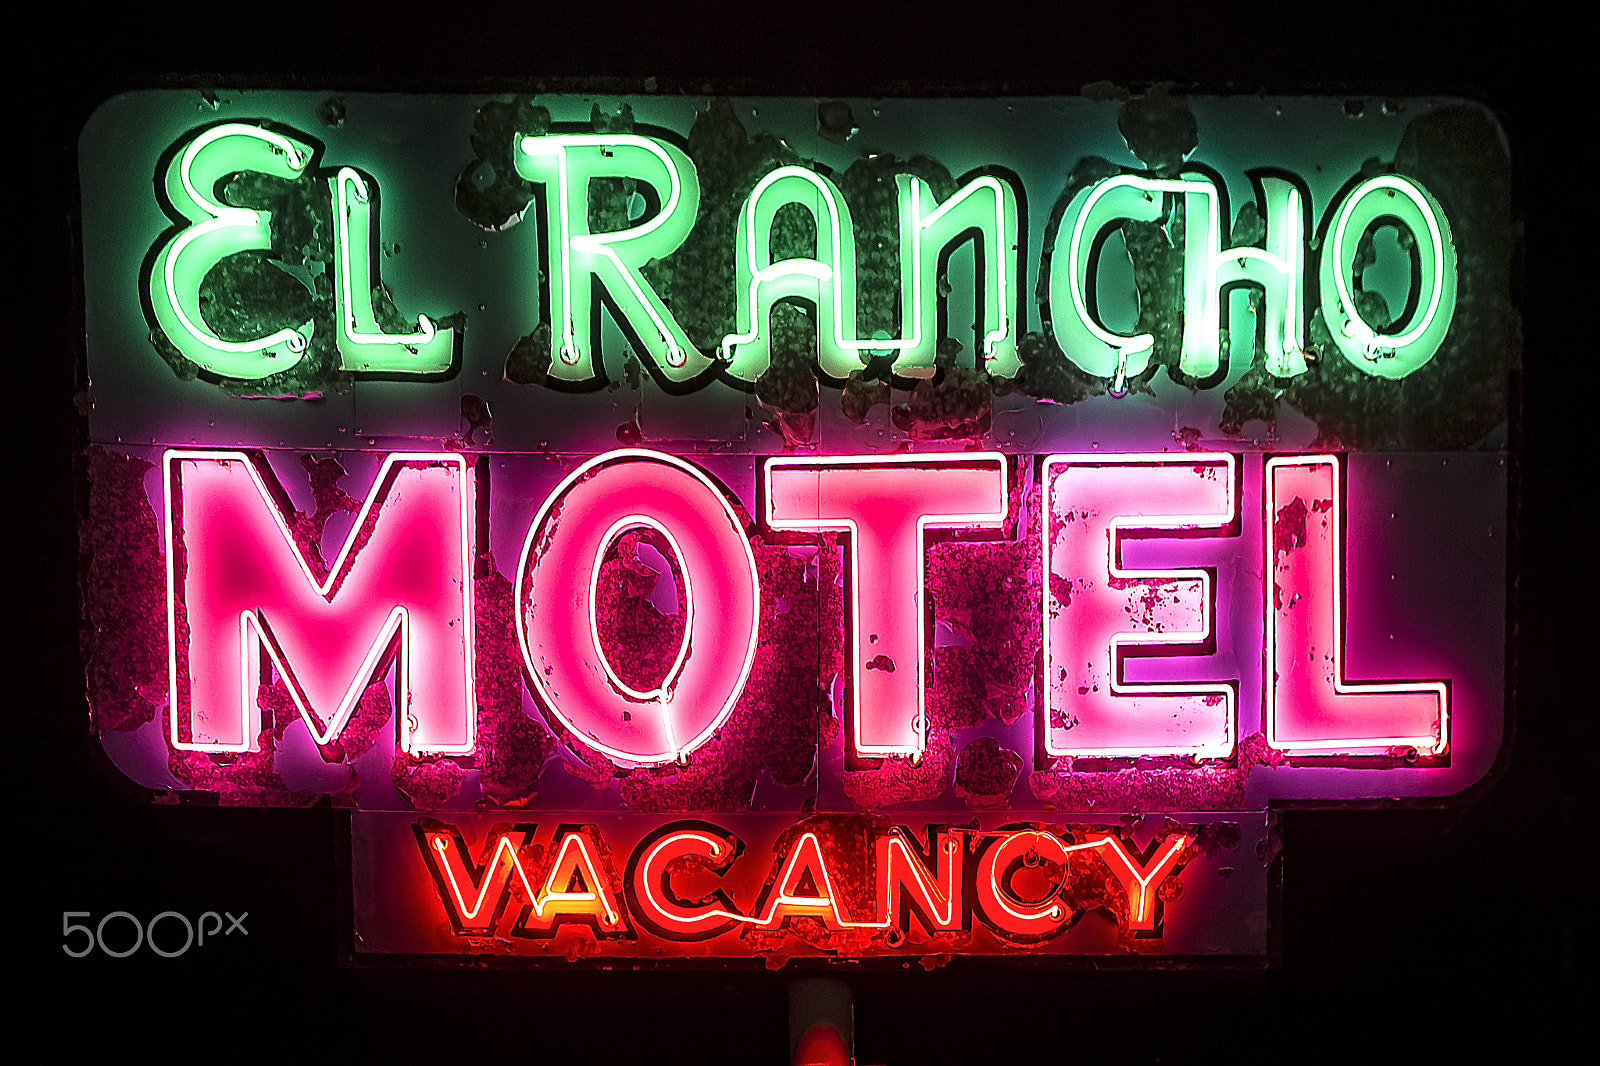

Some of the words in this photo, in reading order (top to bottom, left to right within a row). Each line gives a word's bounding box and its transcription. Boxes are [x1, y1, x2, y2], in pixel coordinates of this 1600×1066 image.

[148, 121, 458, 380] EL
[514, 129, 1457, 382] RANCHO
[163, 448, 1451, 765] MOTEL
[420, 824, 1196, 938] VACANCY
